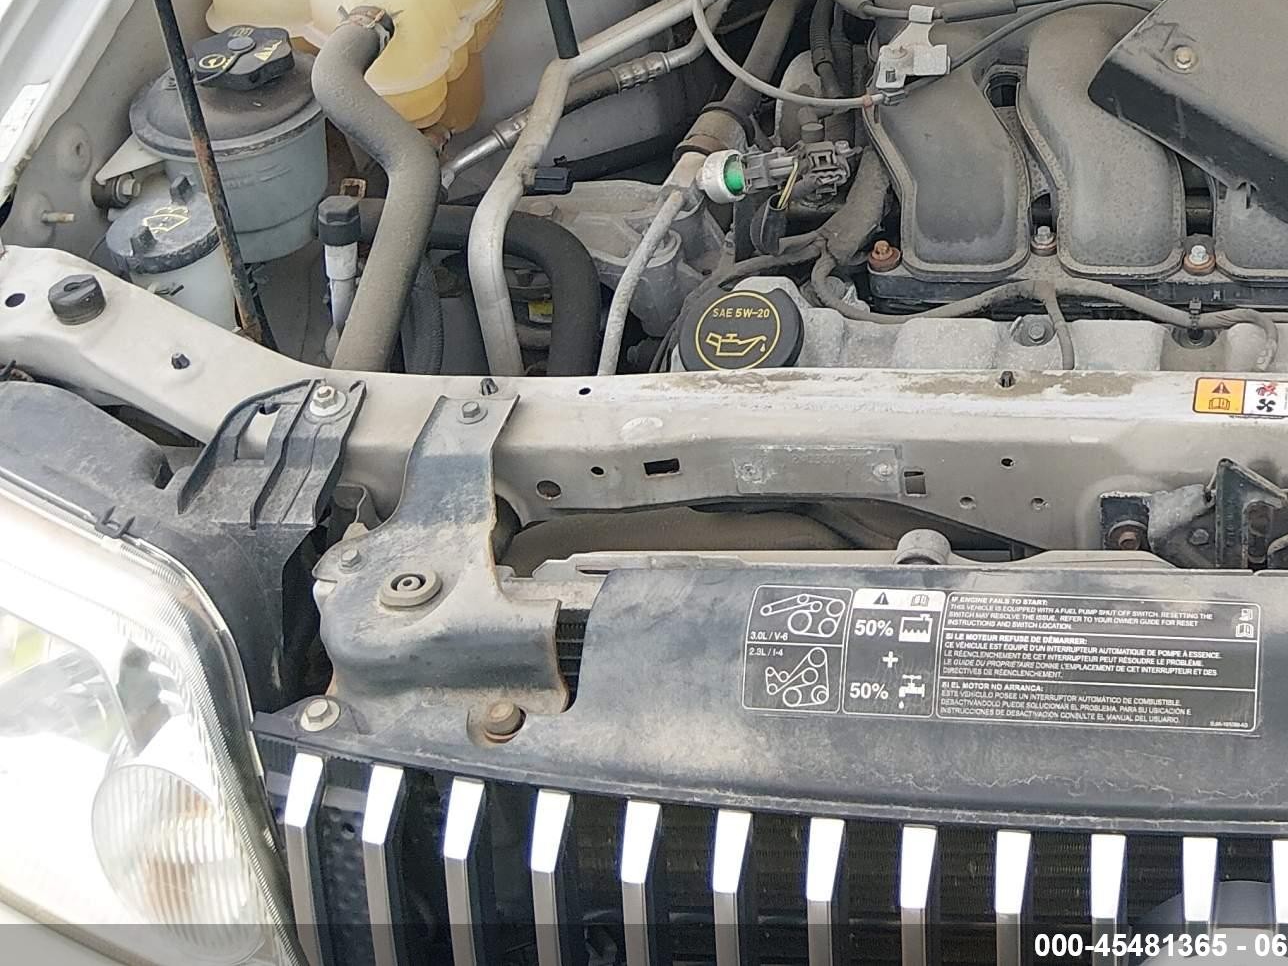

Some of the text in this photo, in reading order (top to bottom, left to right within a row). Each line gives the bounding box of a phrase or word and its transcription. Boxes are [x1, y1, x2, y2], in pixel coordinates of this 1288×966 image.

[713, 308, 770, 318] SAE 5W-20
[854, 619, 893, 637] 50%
[750, 632, 768, 640] 3.0L
[774, 632, 788, 641] V-6
[749, 648, 766, 656] 2.3L
[772, 648, 783, 656] I-4
[850, 683, 889, 699] 50%
